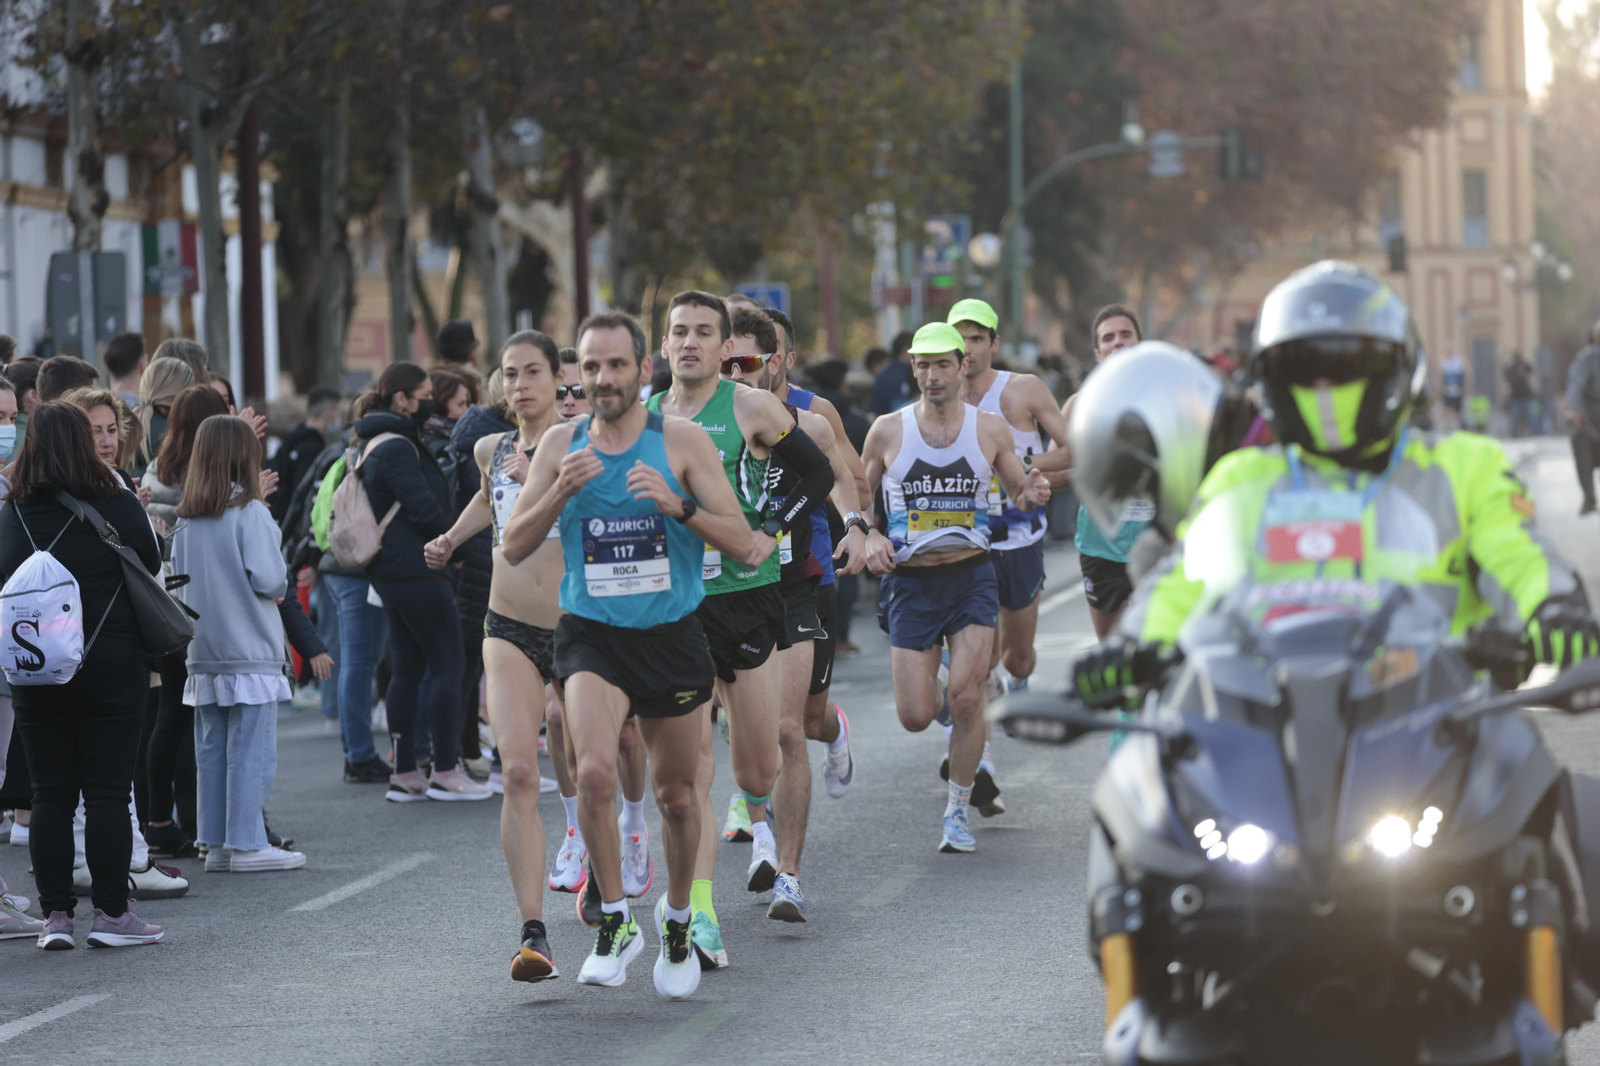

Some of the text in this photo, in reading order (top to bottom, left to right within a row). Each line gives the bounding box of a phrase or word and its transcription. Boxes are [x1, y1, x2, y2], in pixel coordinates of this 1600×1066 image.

[902, 473, 980, 495] BOĞAZİÇİ
[931, 500, 968, 509] ZURICH
[607, 516, 655, 533] ZURICH
[933, 518, 950, 528] 437
[612, 544, 635, 559] 117
[612, 565, 639, 576] ROCA
